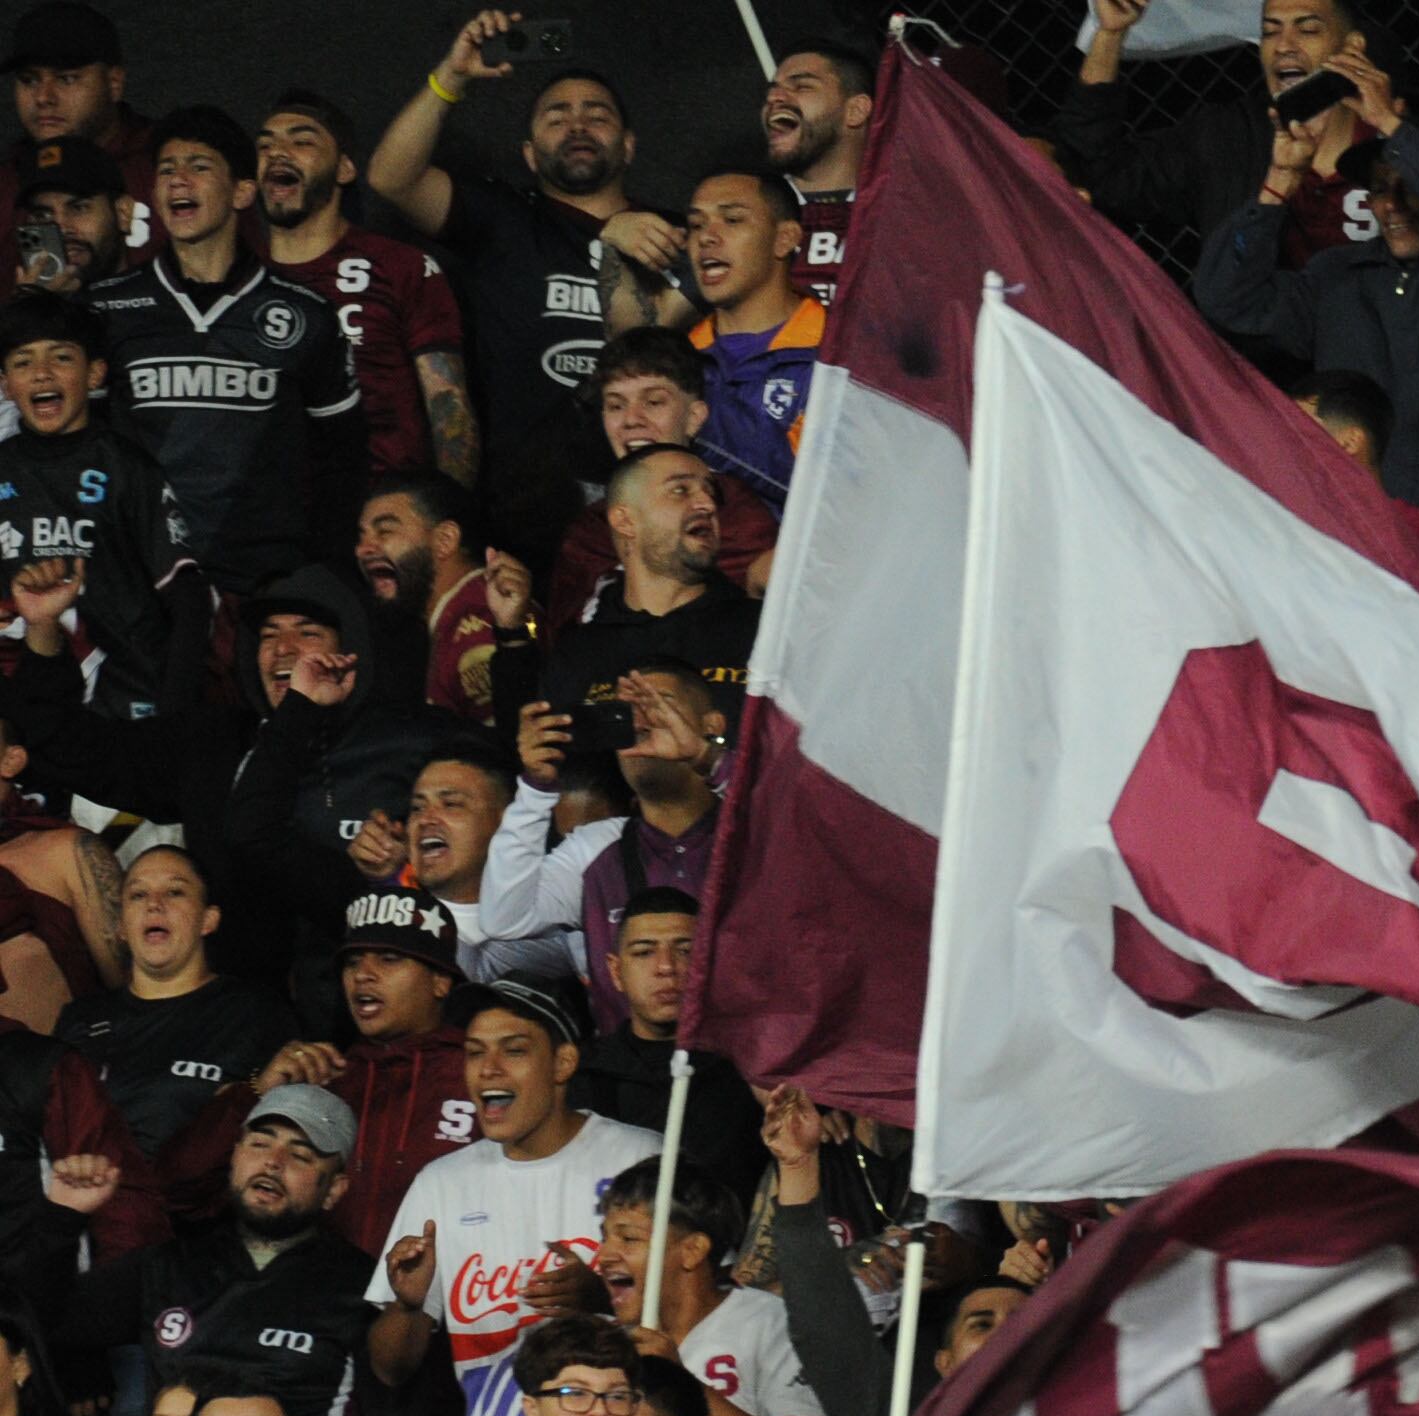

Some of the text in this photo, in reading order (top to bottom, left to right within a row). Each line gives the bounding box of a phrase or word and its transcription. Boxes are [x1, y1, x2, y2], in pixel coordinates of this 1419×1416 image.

[336, 258, 371, 293] S
[106, 297, 157, 310] TOYOTA
[264, 307, 291, 338] S
[129, 365, 278, 401] BIMBO
[78, 469, 107, 503] S
[32, 516, 94, 549] BAC
[438, 1099, 476, 1137] S
[159, 1311, 187, 1343] S
[704, 1354, 739, 1398] S
